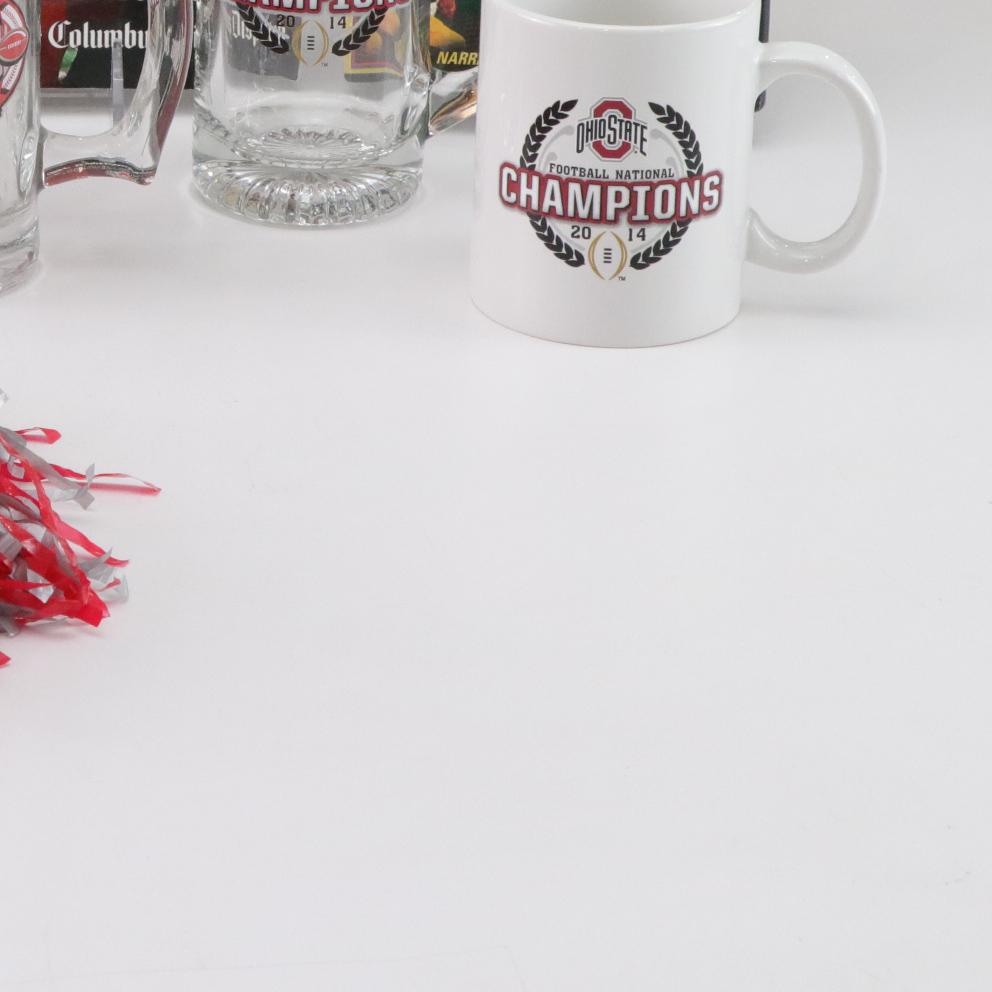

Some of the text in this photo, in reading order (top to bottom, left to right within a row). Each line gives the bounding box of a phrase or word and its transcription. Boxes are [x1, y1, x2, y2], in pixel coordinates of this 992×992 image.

[276, 14, 347, 29] 20 14
[48, 19, 148, 49] Columbu
[437, 51, 478, 65] NARR
[549, 162, 675, 180] FOOTBALL NATIONAL
[501, 165, 721, 222] CHAMPIONS
[571, 225, 647, 242] 20 14
